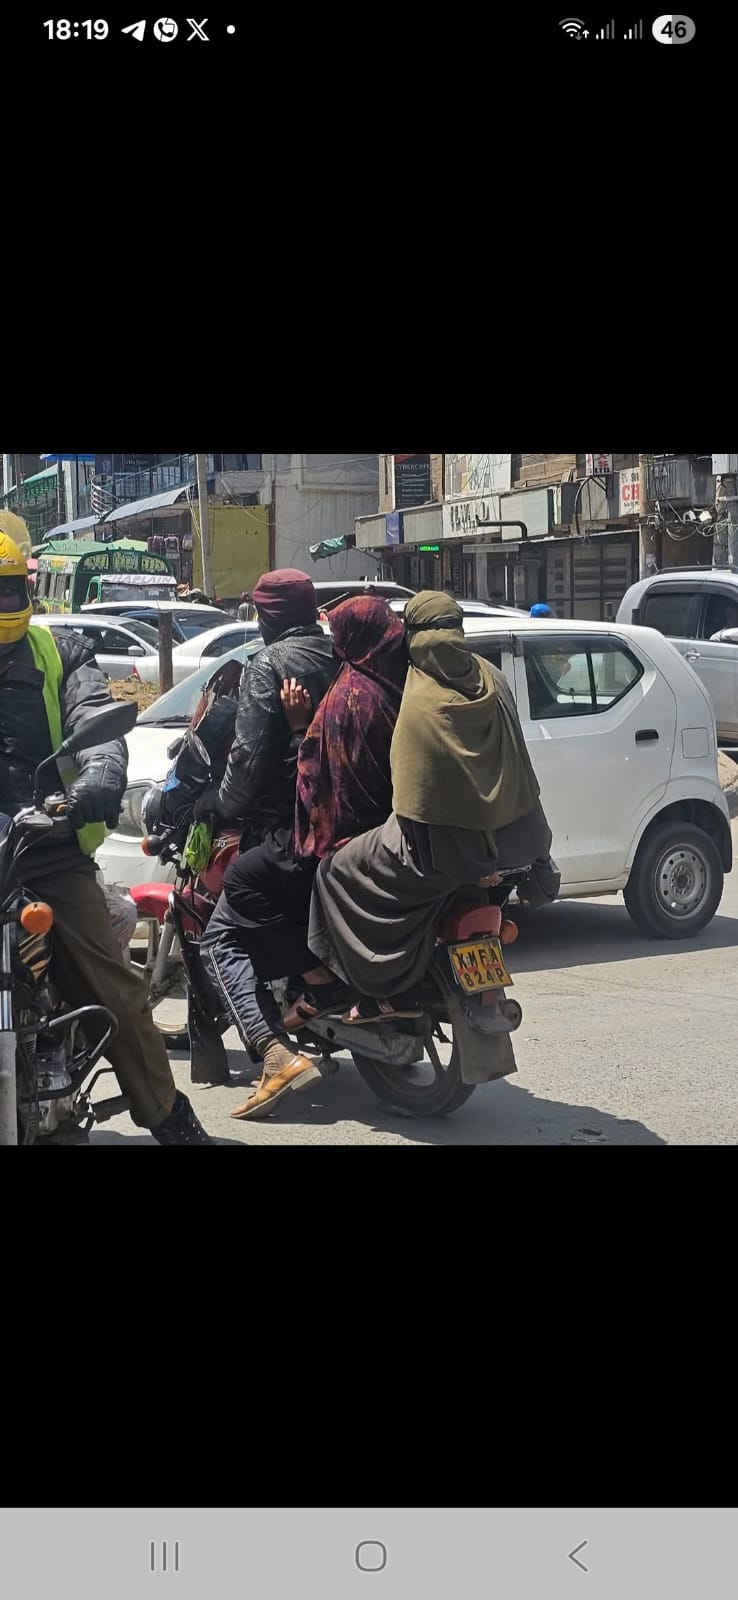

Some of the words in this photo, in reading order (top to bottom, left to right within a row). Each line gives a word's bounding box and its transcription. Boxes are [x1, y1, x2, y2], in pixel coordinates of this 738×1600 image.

[103, 575, 173, 585] CHAPLAIN
[456, 948, 499, 970] KMFA
[463, 968, 504, 988] 824P
